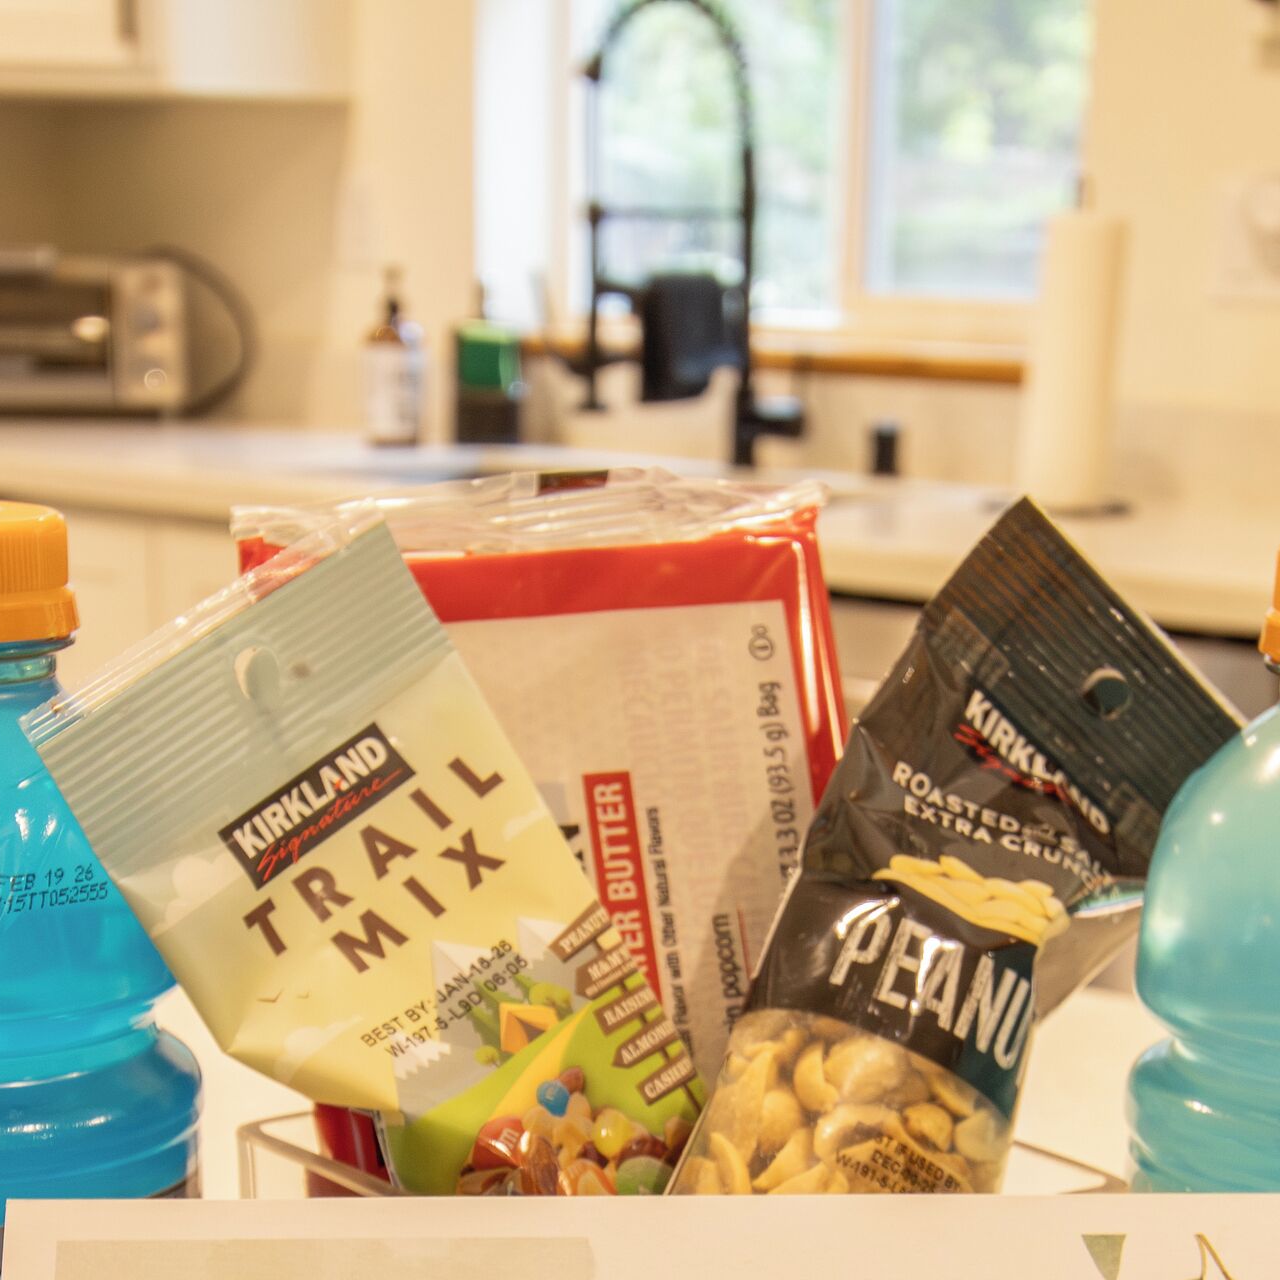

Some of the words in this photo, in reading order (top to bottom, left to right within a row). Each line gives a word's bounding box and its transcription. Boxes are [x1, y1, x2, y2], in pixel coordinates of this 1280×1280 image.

[756, 681, 782, 718] Bag
[761, 716, 789, 742] g)
[764, 745, 795, 795] (93.5
[233, 737, 389, 859] KIRKLAND
[772, 798, 796, 824] OZ
[892, 760, 1020, 834] ROASTED
[903, 794, 993, 844] EXTRA
[255, 768, 403, 881] Signature
[593, 782, 638, 901] BUTTER
[646, 806, 666, 855] Flavors
[45, 867, 65, 888] 19
[74, 862, 94, 883] 26
[241, 757, 506, 957] TRAIL
[652, 857, 672, 907] Natural
[330, 828, 506, 974] MIX
[660, 912, 677, 948] Other
[667, 951, 681, 980] with
[360, 1015, 407, 1048] BEST
